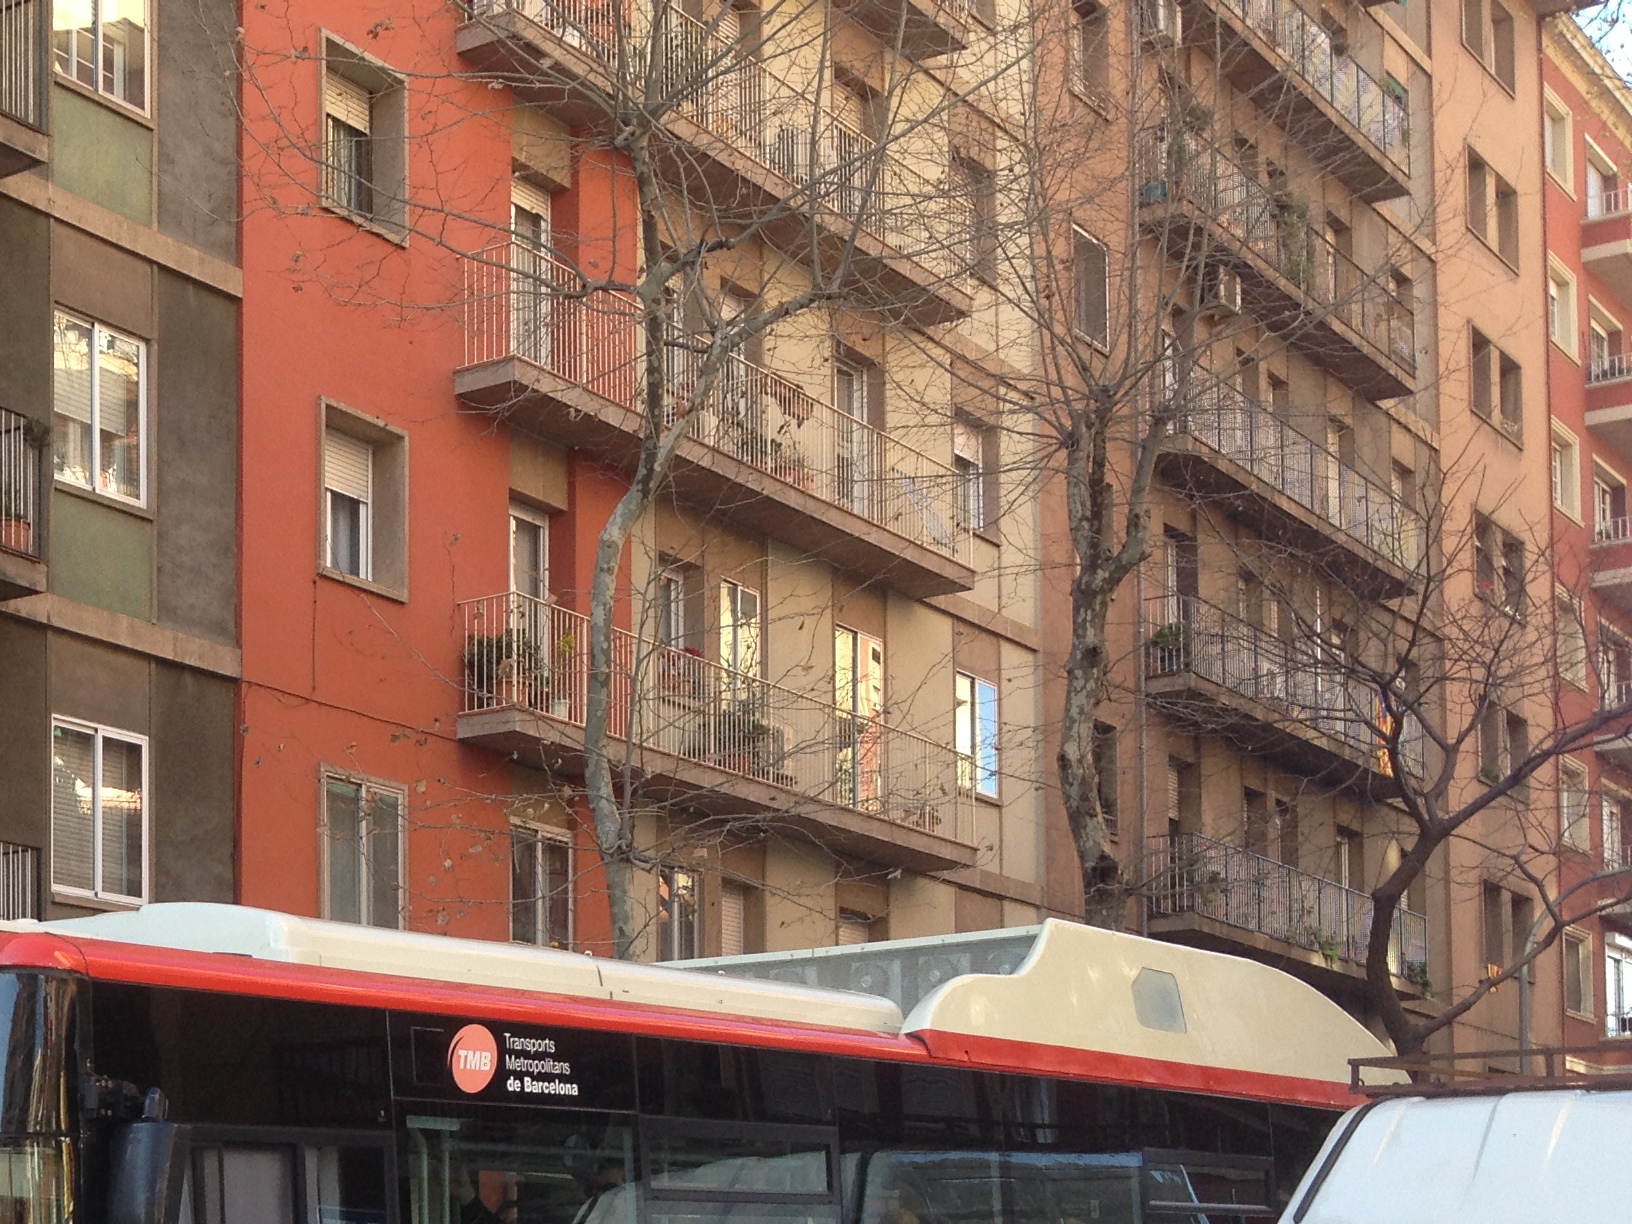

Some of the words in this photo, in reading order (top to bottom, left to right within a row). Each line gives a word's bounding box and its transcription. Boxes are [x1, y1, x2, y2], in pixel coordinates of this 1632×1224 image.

[503, 1032, 555, 1054] Transports
[458, 1049, 491, 1071] TMB
[505, 1053, 571, 1076] Metropolitans
[506, 1075, 521, 1092] de
[523, 1076, 579, 1096] Barcelona
